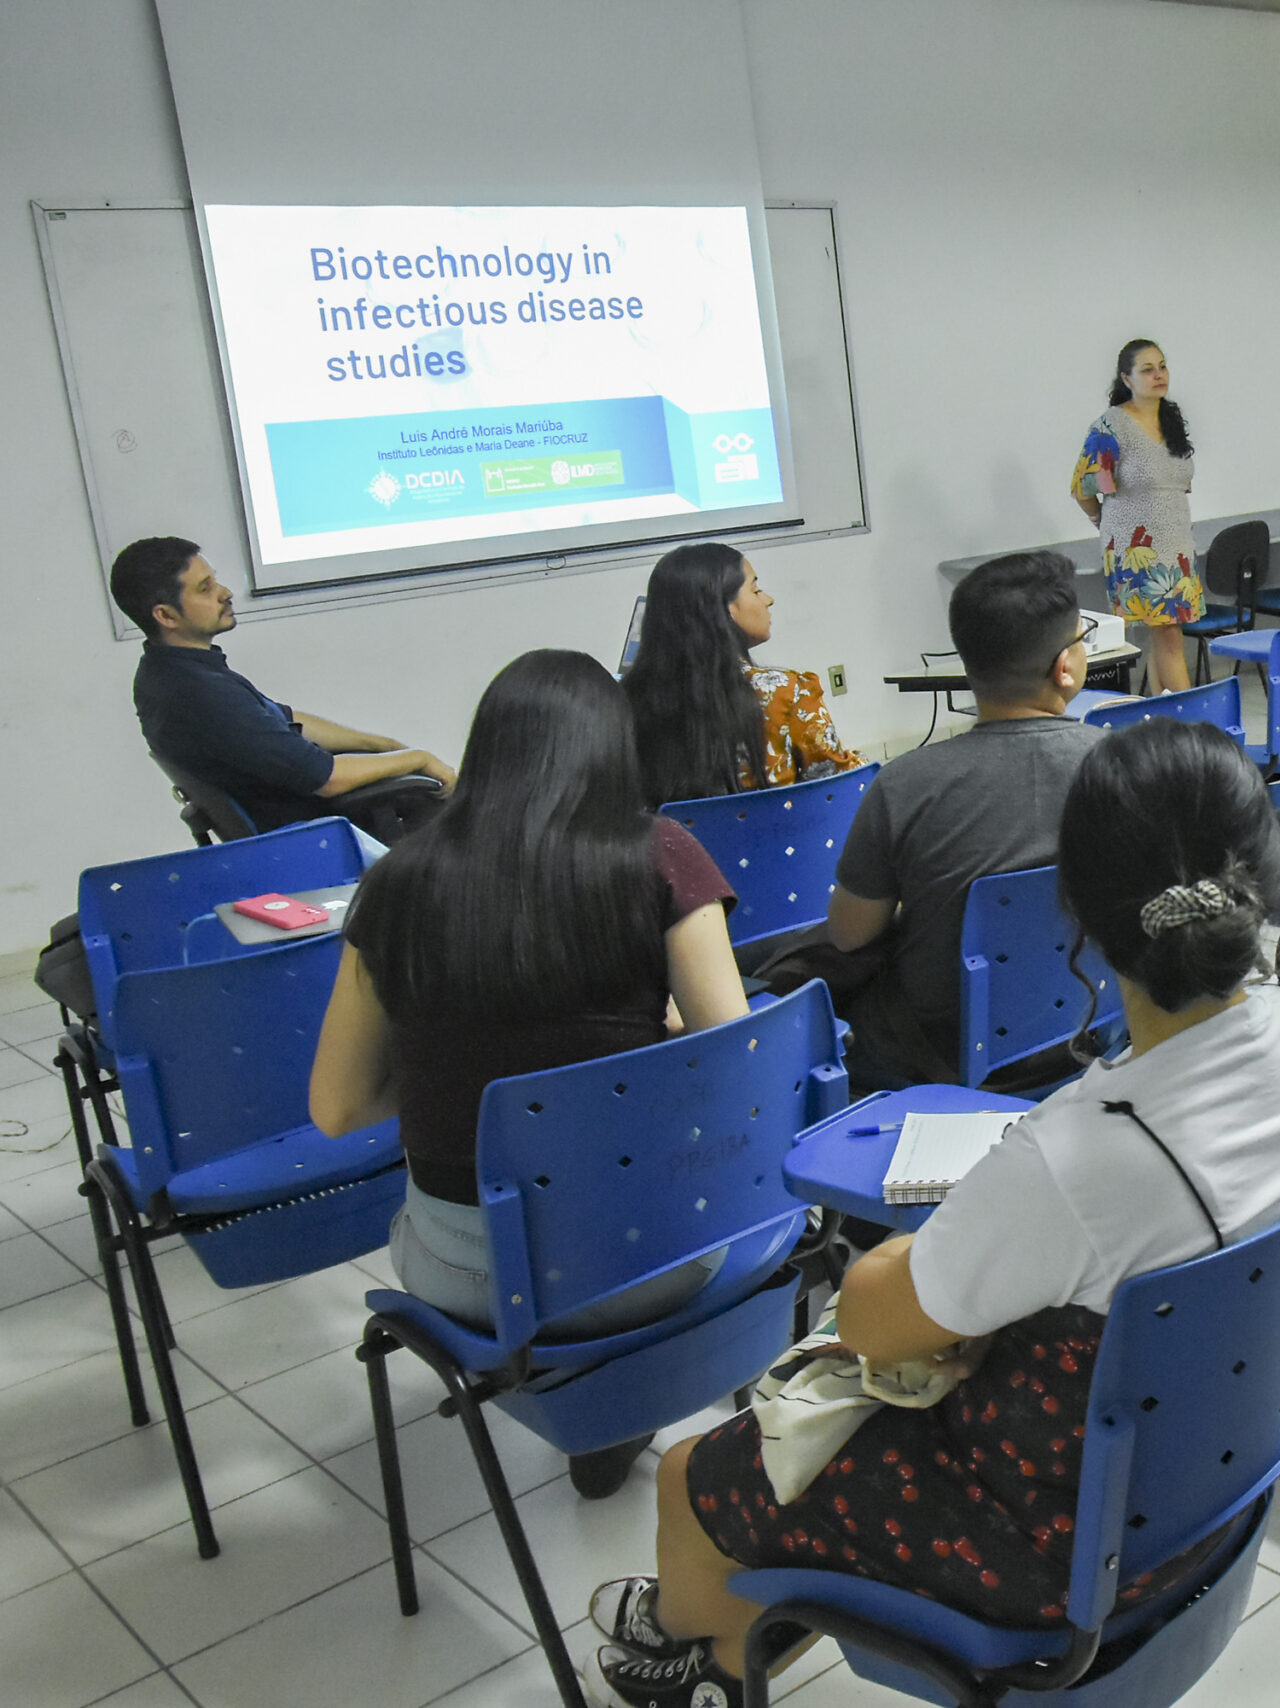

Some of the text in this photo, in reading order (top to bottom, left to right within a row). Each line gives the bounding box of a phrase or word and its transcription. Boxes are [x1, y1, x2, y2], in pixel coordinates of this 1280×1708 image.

[310, 243, 612, 284] Biotechnology in
[317, 290, 644, 332] infectious disease
[327, 343, 467, 382] studies
[377, 448, 417, 460] Instituto
[466, 444, 473, 453] e
[475, 441, 502, 452] Maria
[504, 439, 535, 449] Deane
[543, 432, 588, 446] FIOCRUZ
[400, 419, 564, 444] Luis André Morais Mariúba
